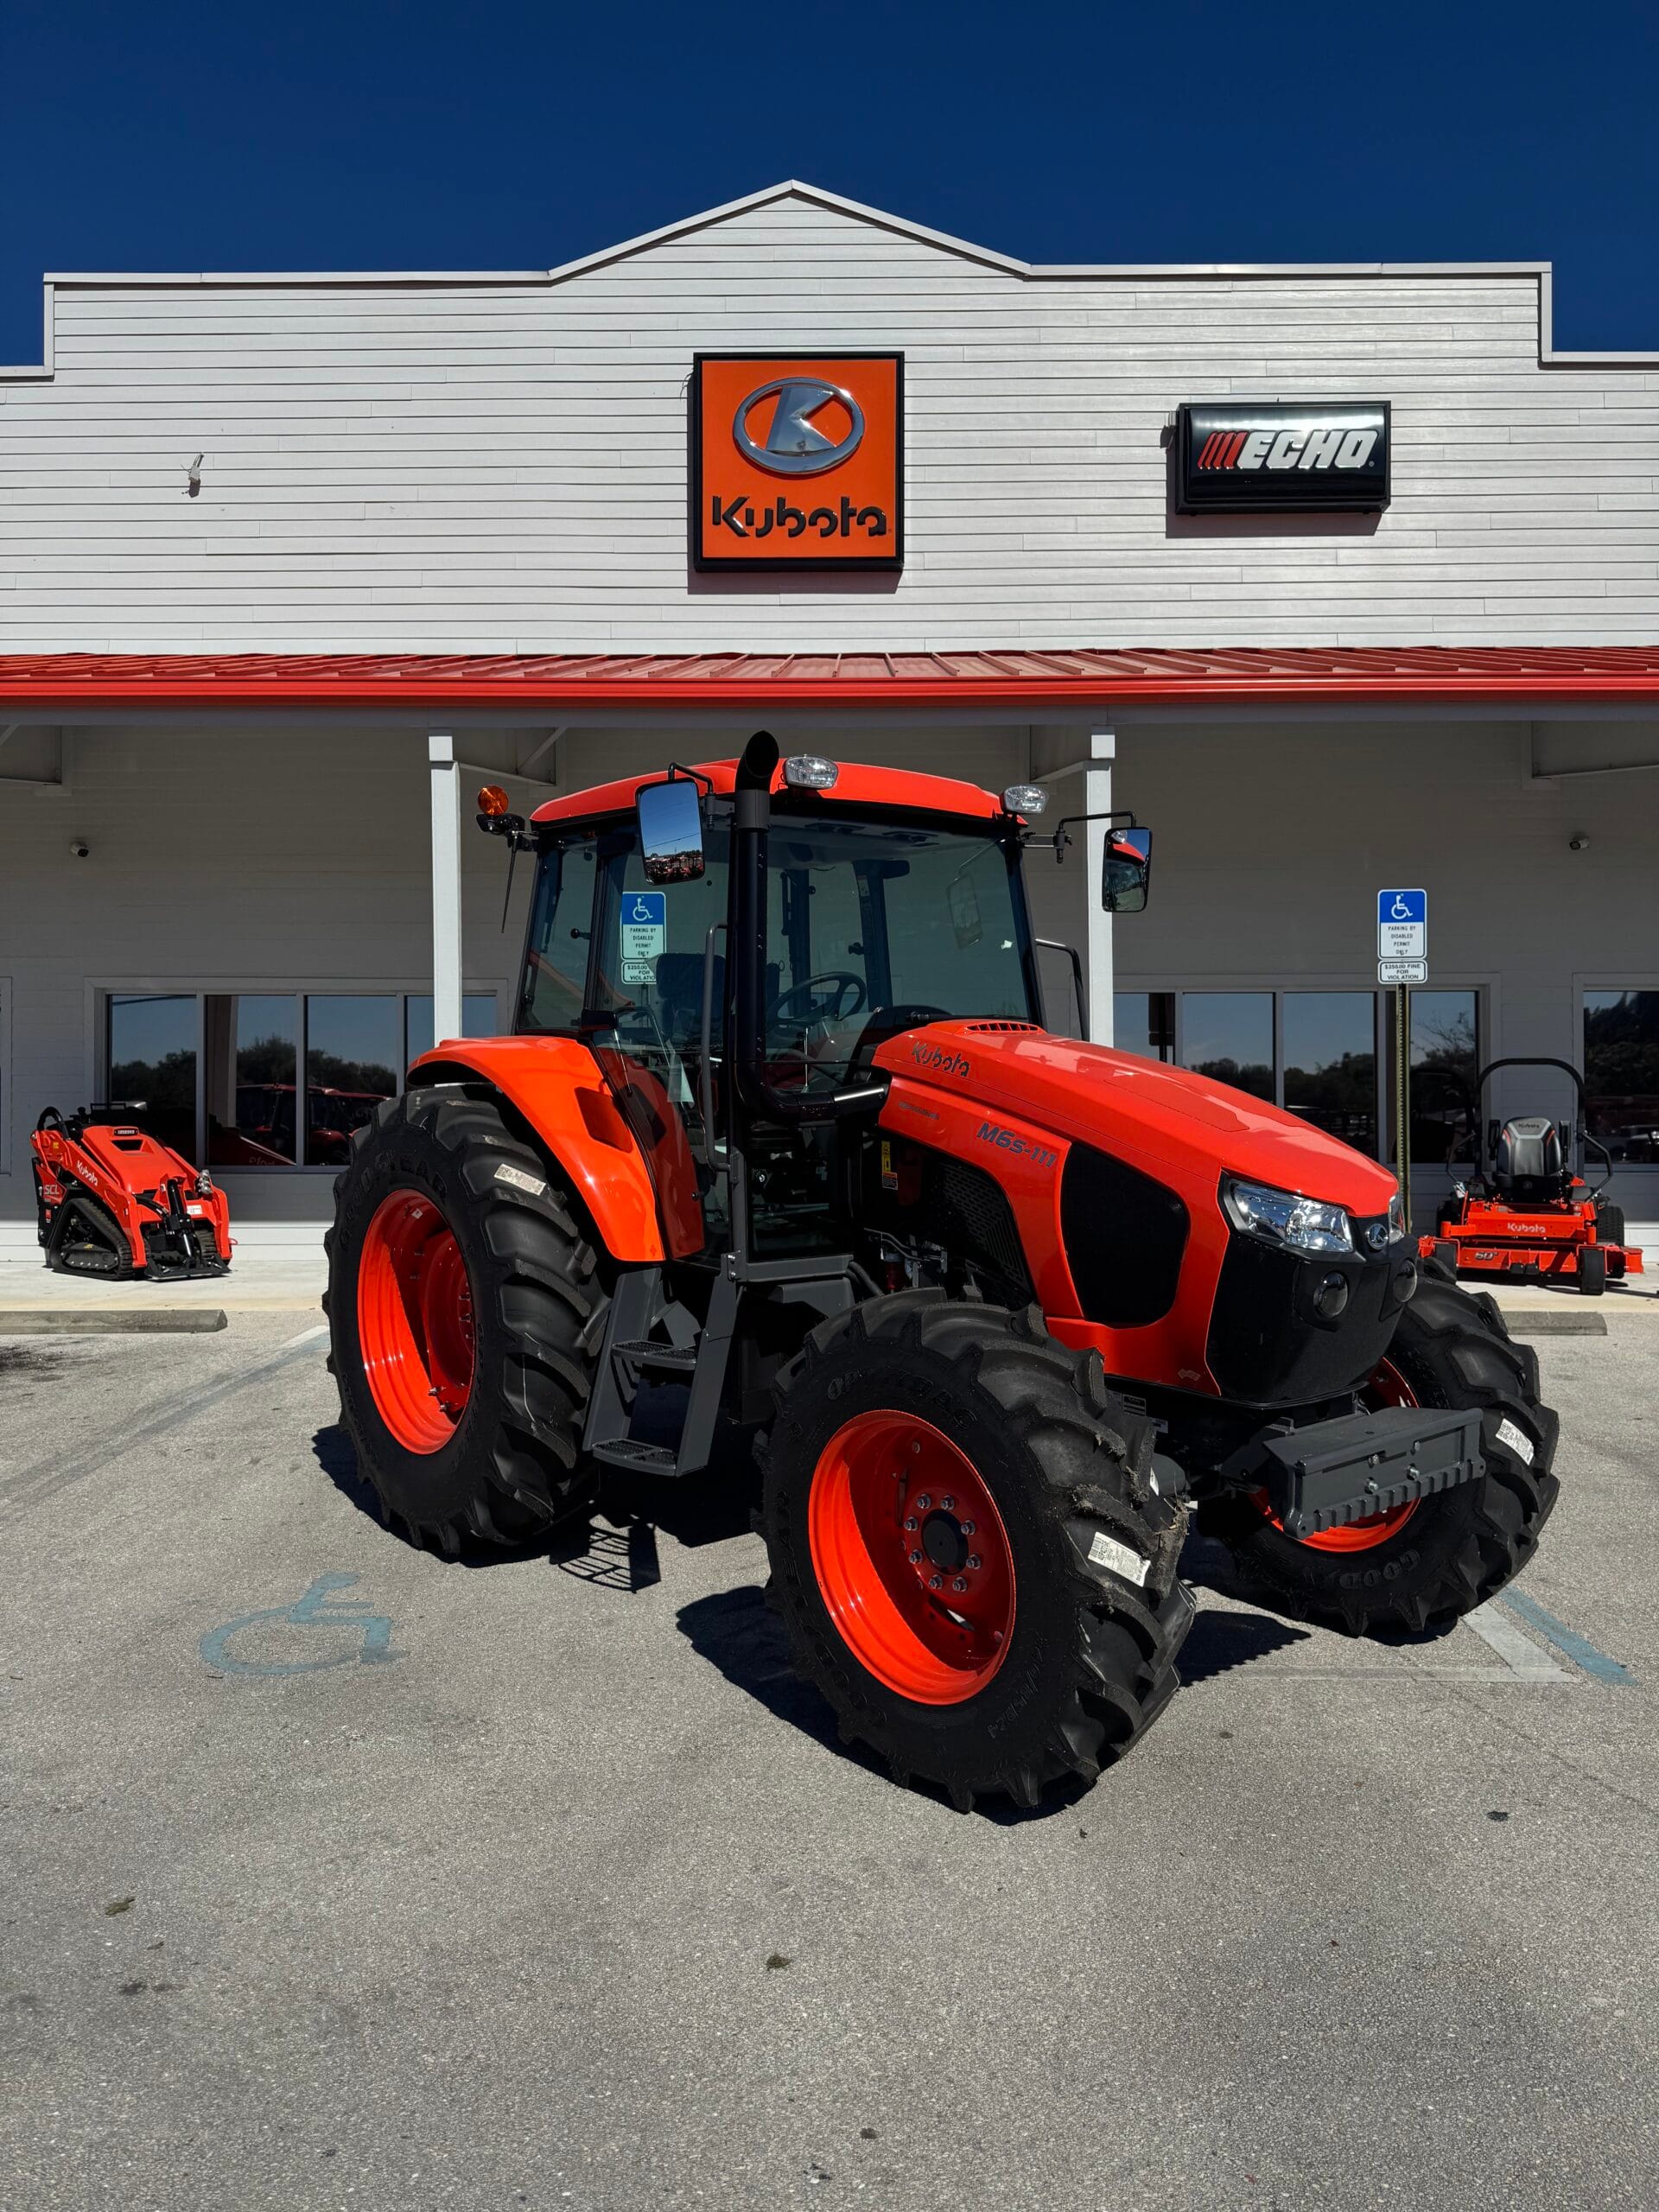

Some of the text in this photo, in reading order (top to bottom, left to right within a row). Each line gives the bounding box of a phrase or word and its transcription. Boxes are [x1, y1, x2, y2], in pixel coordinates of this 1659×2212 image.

[1236, 429, 1378, 469] ECHO
[712, 496, 887, 538] Kubota
[912, 1040, 971, 1078] Kubota
[976, 1122, 1058, 1167] M6S-111
[44, 1184, 60, 1195] SCL
[77, 1160, 99, 1187] Kubota
[1507, 1222, 1547, 1234] Kubota
